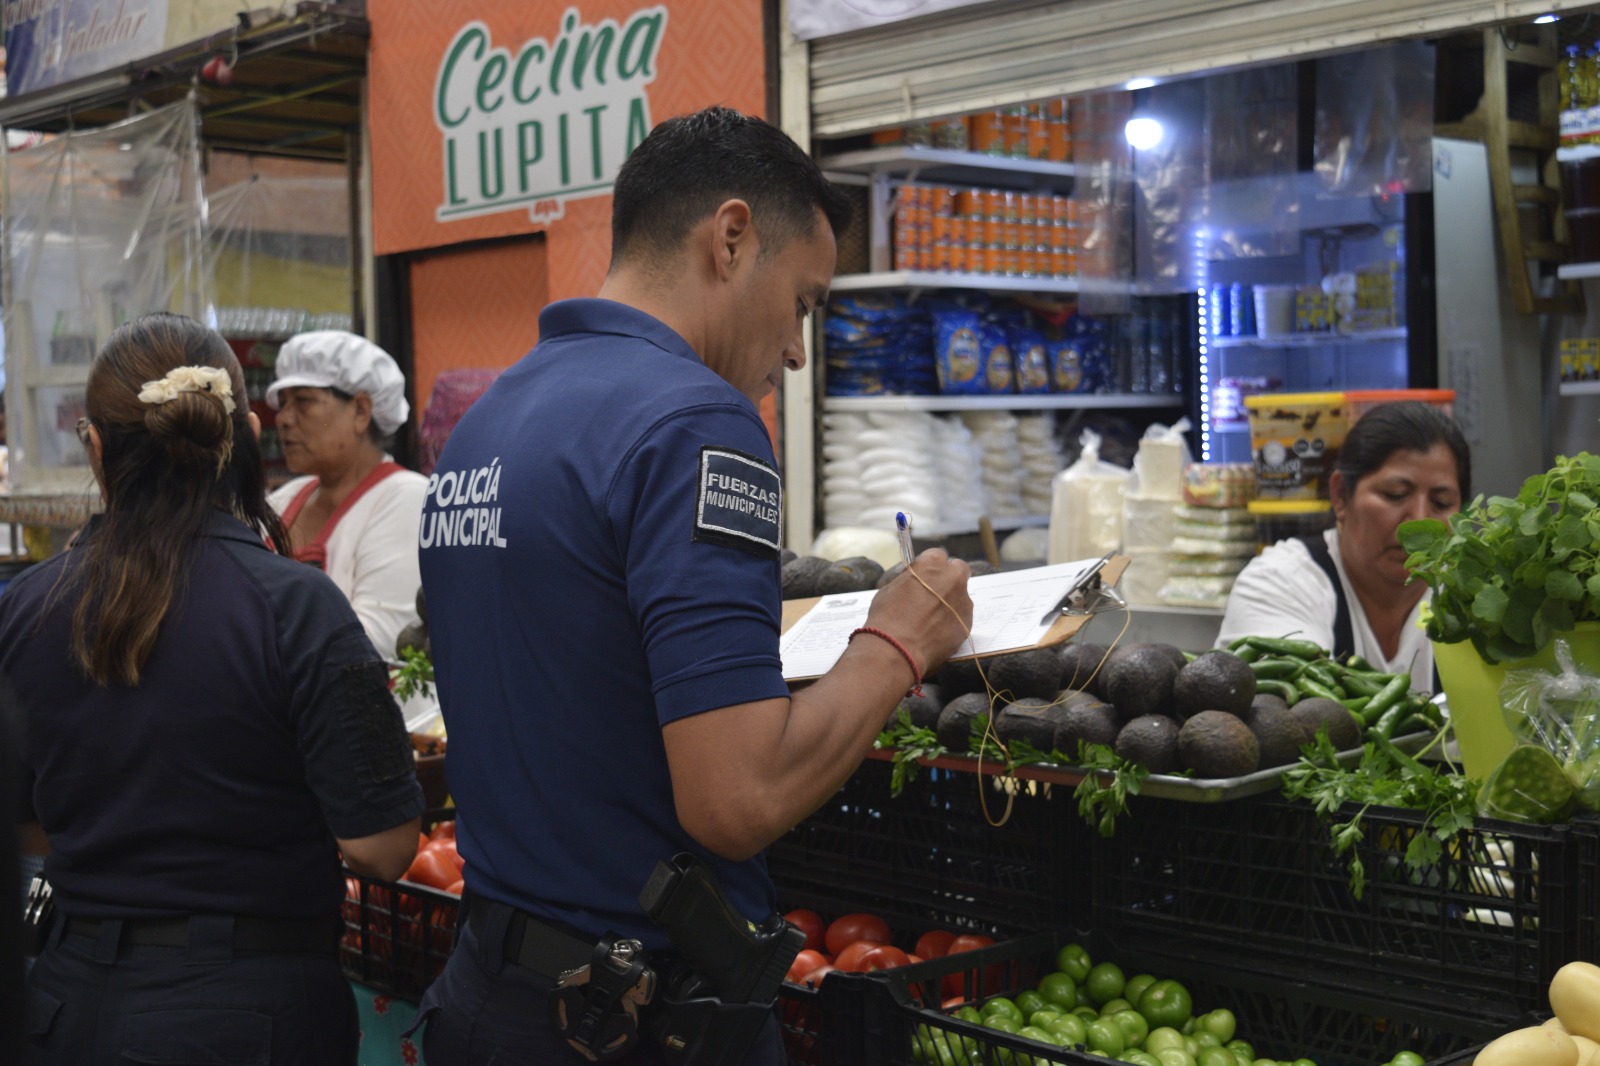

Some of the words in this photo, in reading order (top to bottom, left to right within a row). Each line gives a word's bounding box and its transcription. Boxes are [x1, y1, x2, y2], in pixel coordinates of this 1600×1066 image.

[437, 13, 663, 129] Cecina
[447, 97, 650, 206] LUPITA
[422, 456, 502, 508] POLICÍA
[707, 473, 778, 507] FUERZAS
[419, 507, 507, 549] UNICIPAL
[706, 490, 778, 524] MUNICIPALES
